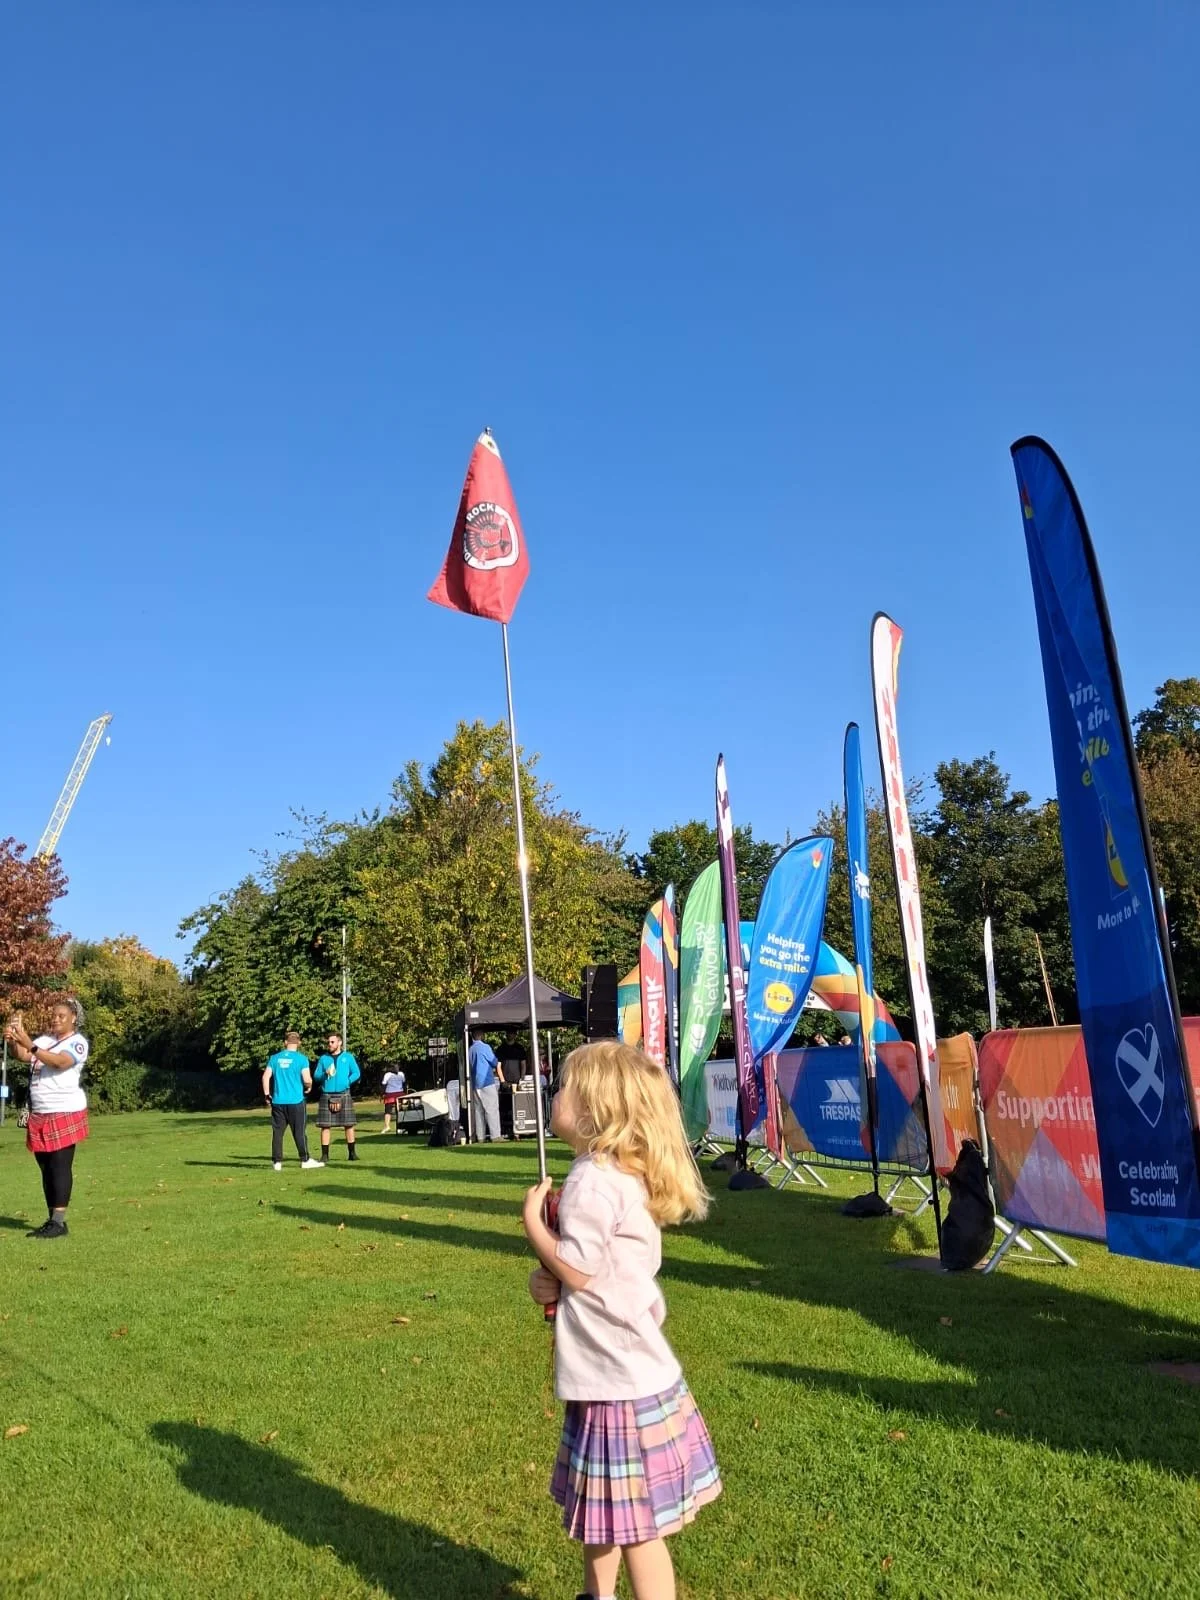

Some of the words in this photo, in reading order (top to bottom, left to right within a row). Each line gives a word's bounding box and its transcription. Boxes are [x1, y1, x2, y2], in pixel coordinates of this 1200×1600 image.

[466, 502, 494, 522] ROCK
[1097, 911, 1123, 930] More
[1123, 905, 1132, 920] to
[760, 944, 777, 956] you
[778, 950, 791, 961] go
[793, 952, 811, 962] the
[767, 932, 806, 953] Helping
[703, 923, 720, 1016] Networks
[759, 956, 783, 970] extra
[783, 963, 809, 974] mile.
[820, 1104, 861, 1121] TRESPAS
[997, 1086, 1095, 1128] Supportin
[1118, 1160, 1179, 1184] Celebrating
[1130, 1187, 1176, 1208] Scotland
